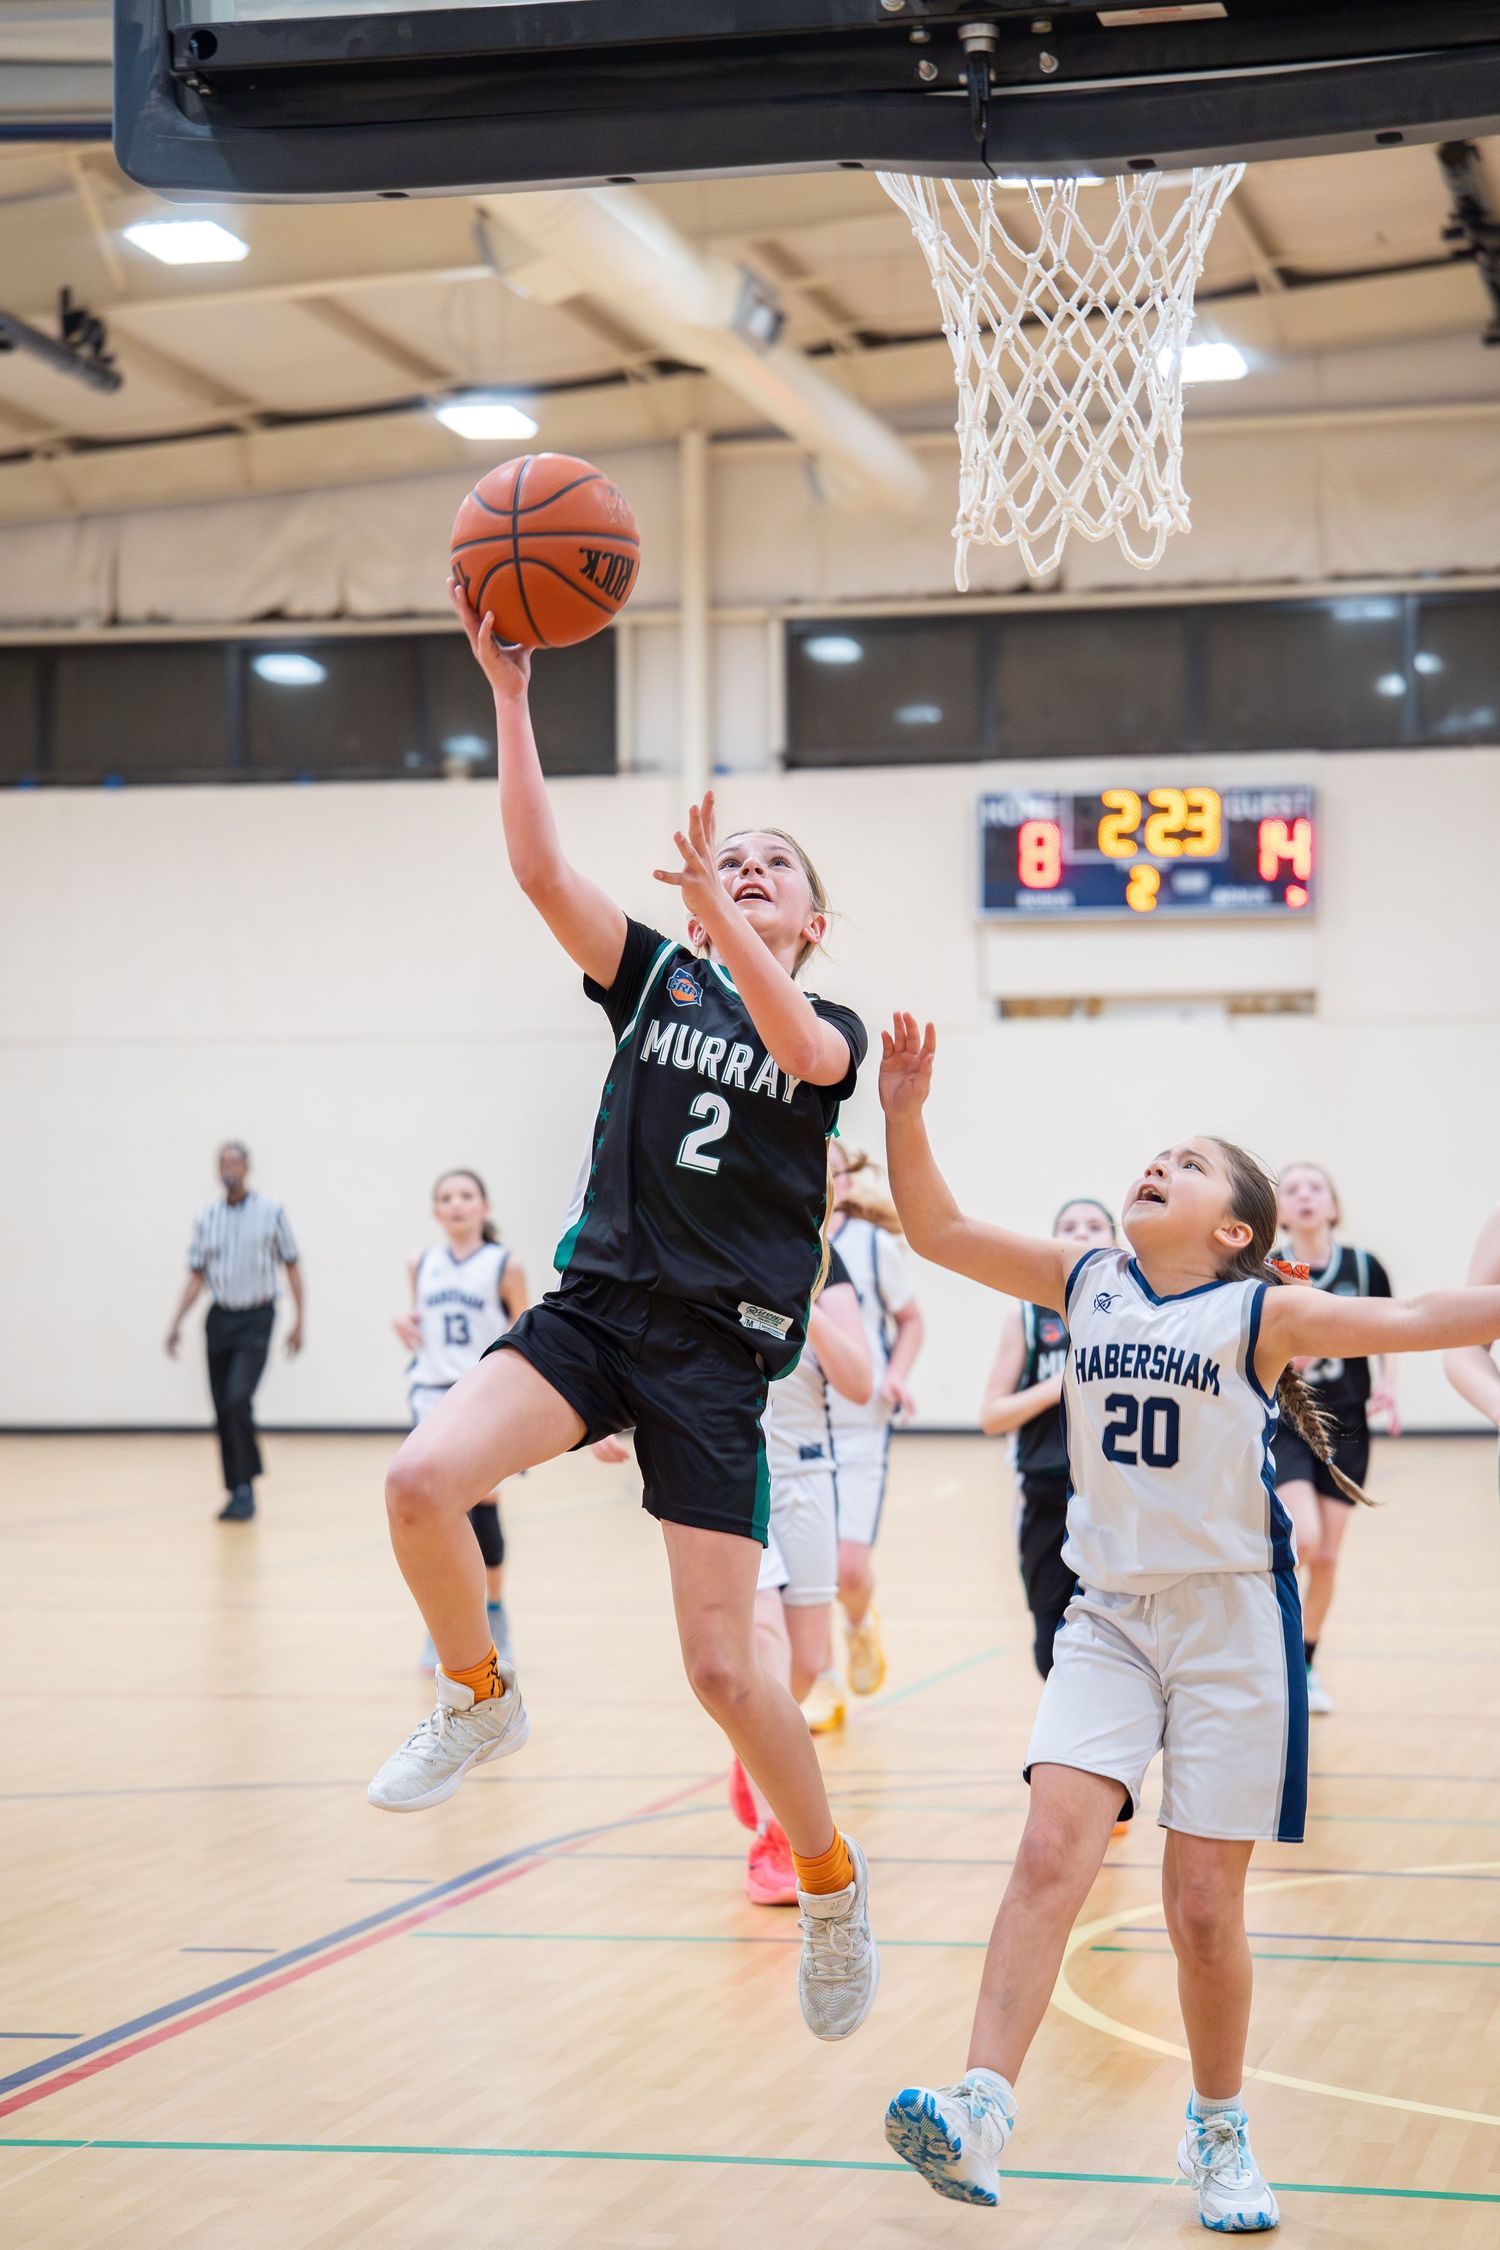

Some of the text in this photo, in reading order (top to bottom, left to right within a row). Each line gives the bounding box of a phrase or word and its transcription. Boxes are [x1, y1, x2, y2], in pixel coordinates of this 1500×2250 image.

[1019, 820, 1061, 888] 8
[640, 1019, 801, 1104] MURRAY
[676, 1092, 731, 1175] 2
[1074, 1343, 1220, 1397] HABERSHAM
[1102, 1393, 1180, 1468] 20
